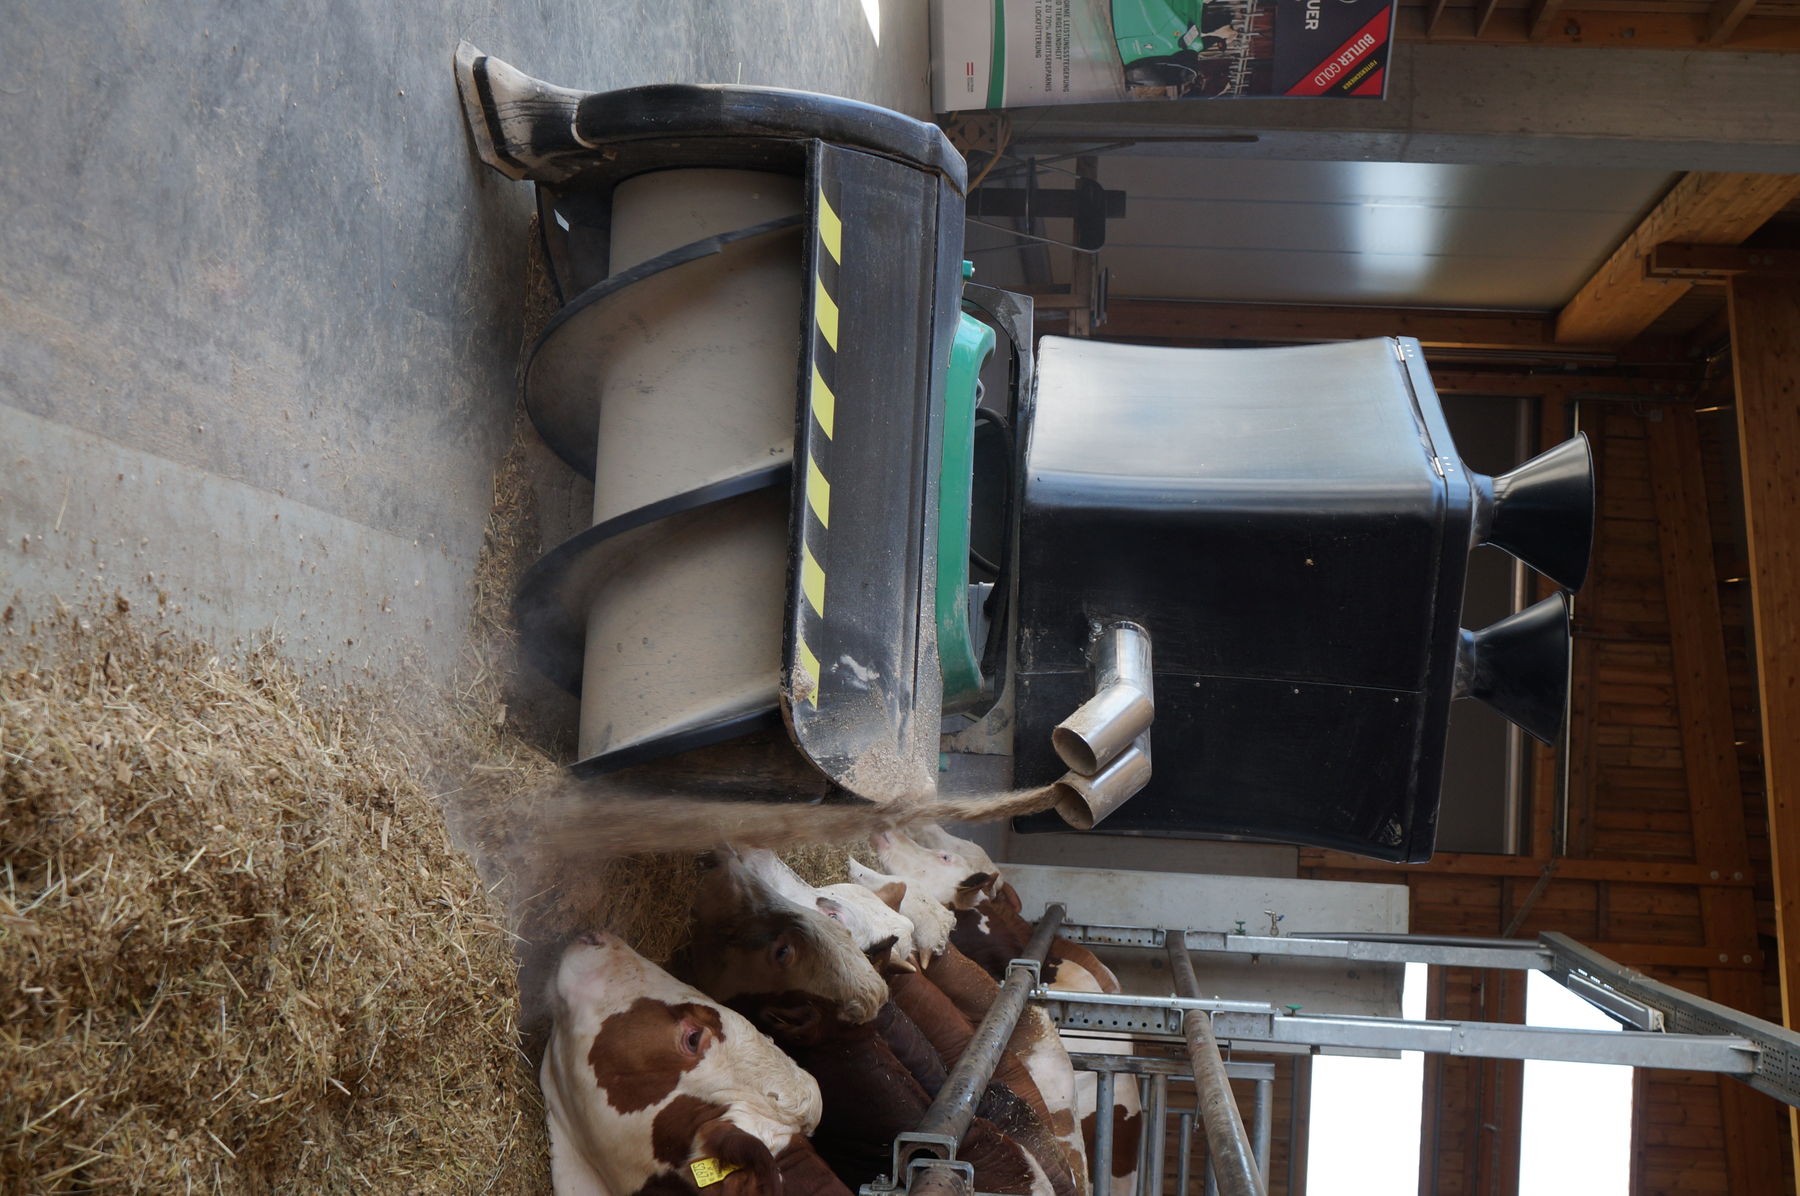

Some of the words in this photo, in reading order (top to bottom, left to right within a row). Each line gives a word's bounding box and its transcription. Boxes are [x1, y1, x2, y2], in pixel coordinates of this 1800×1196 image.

[1046, 5, 1052, 13] ZU
[1337, 34, 1376, 66] BUTLER
[1314, 62, 1341, 86] GOLD
